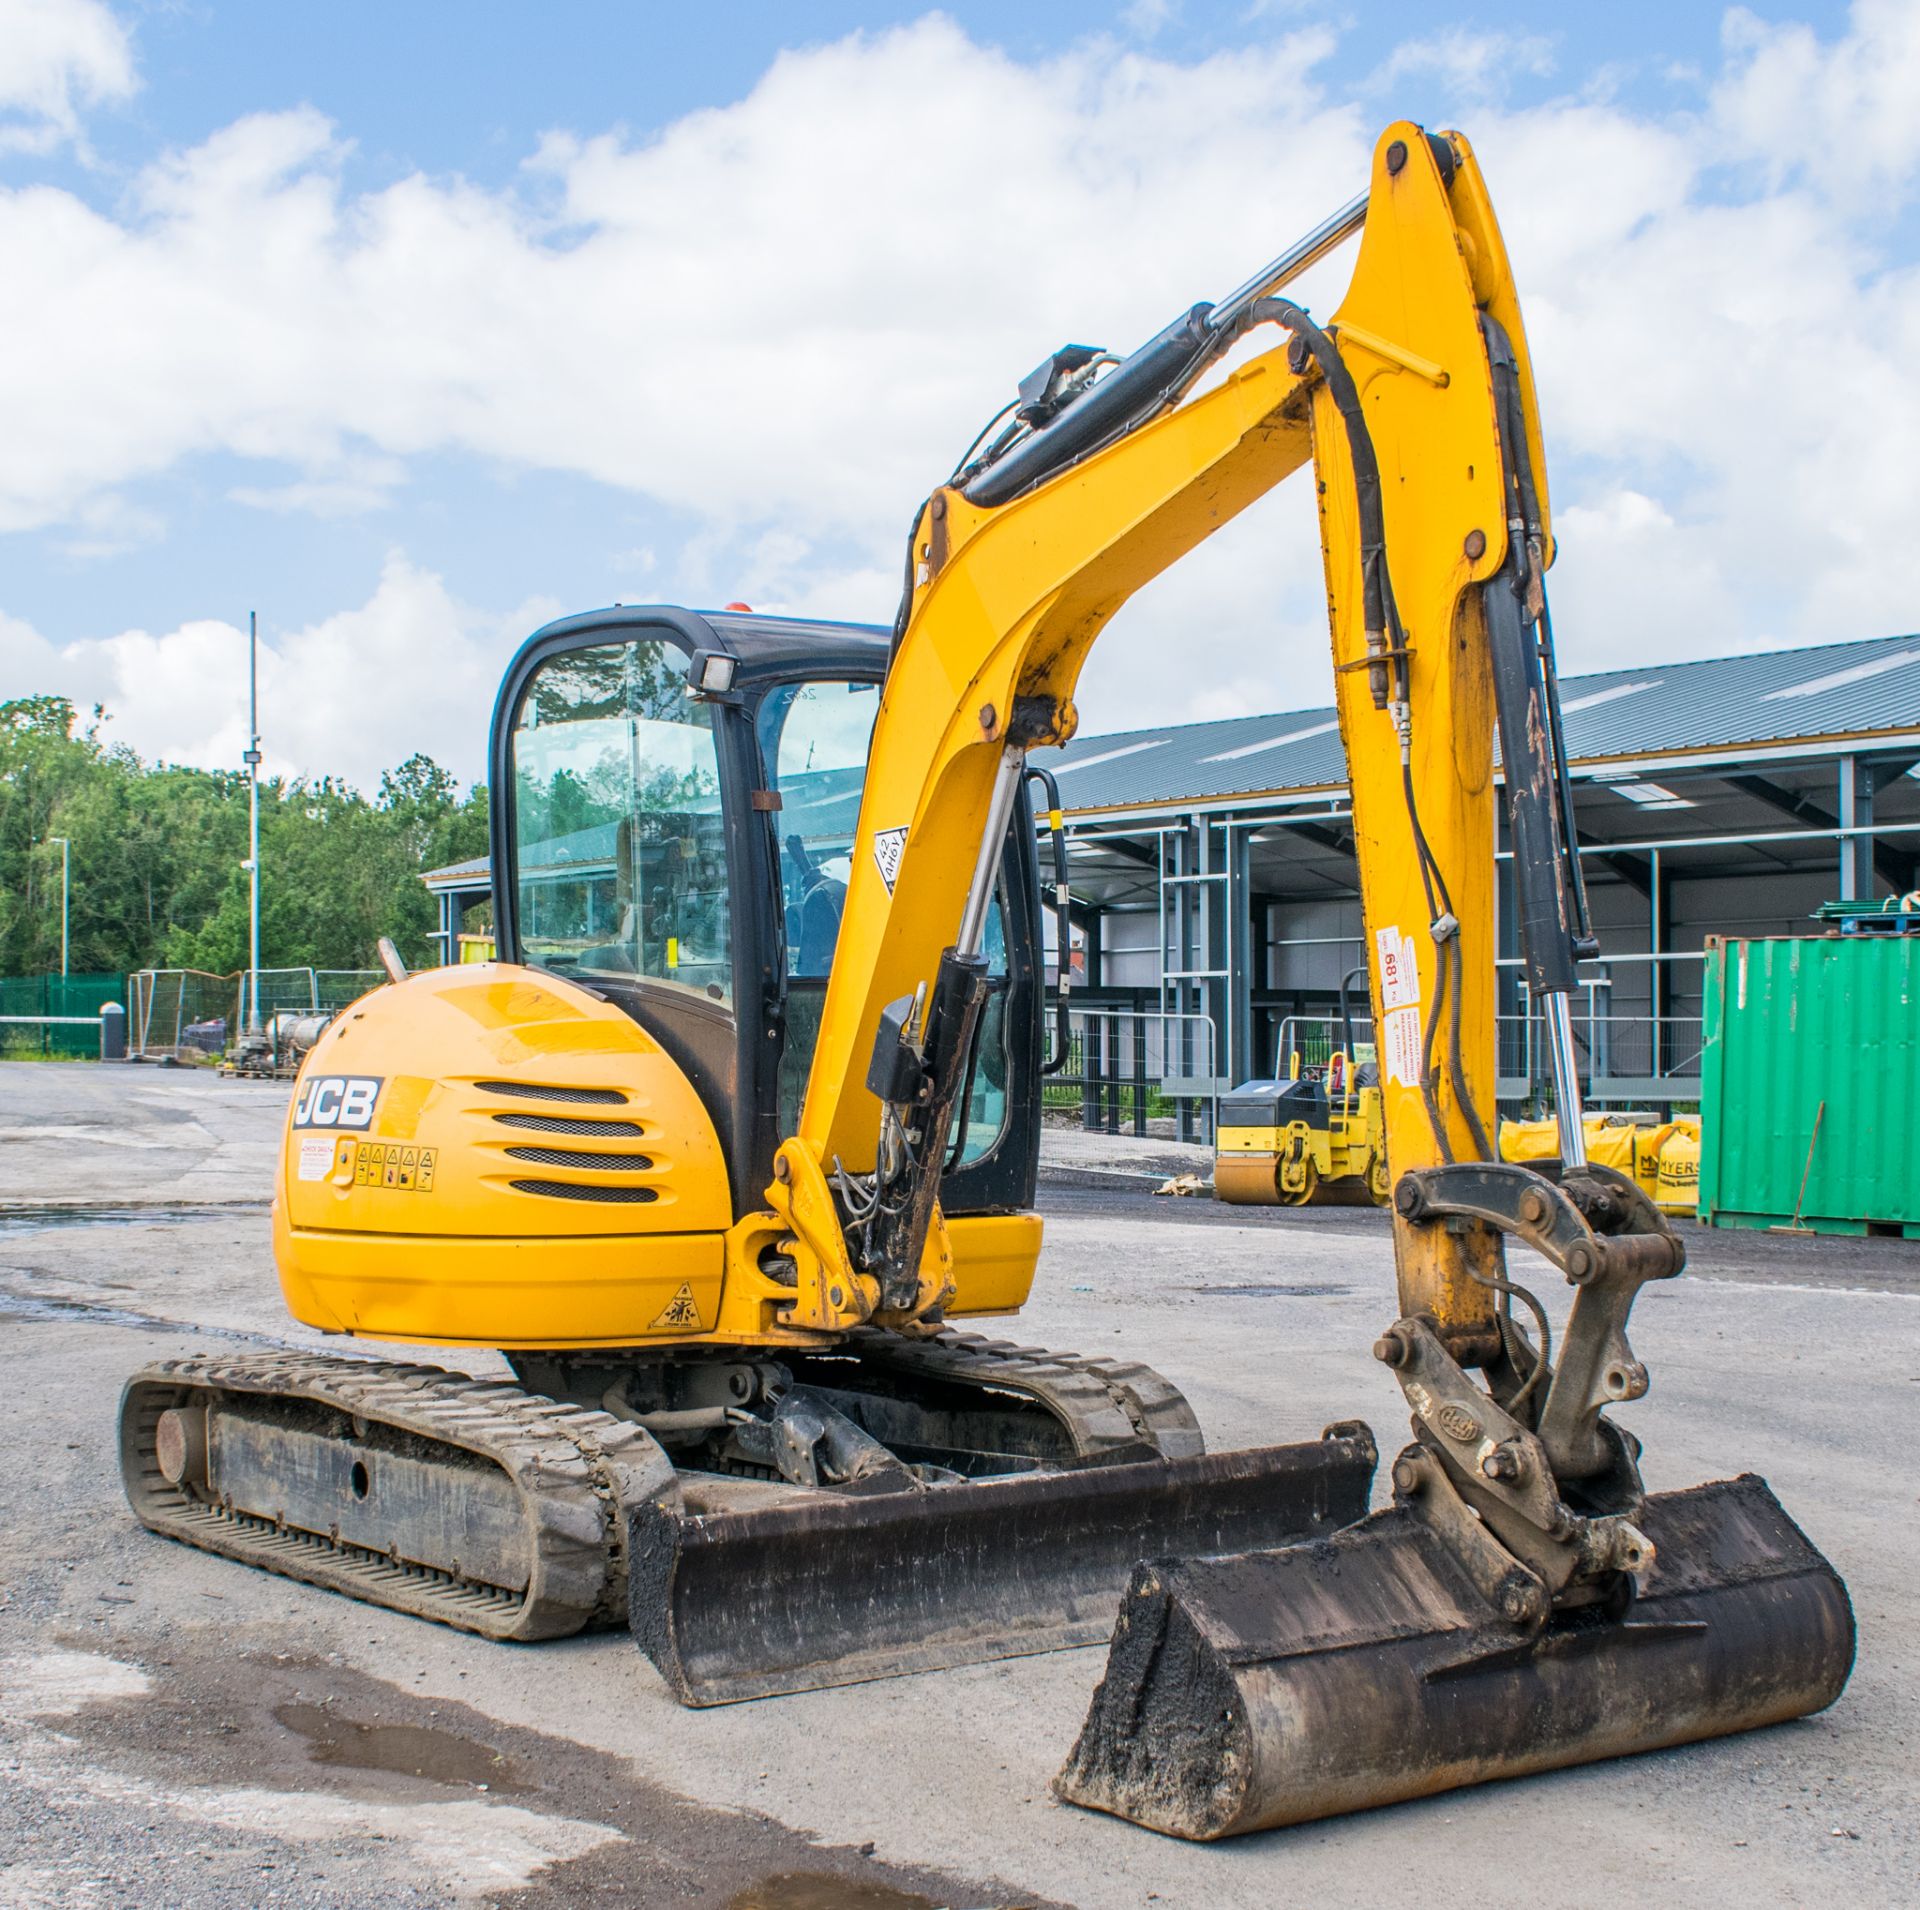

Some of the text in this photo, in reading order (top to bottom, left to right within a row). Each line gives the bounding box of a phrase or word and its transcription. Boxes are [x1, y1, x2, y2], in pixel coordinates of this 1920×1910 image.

[879, 838, 889, 859] 42
[1385, 953, 1398, 986] 681
[295, 1079, 379, 1126] JCB
